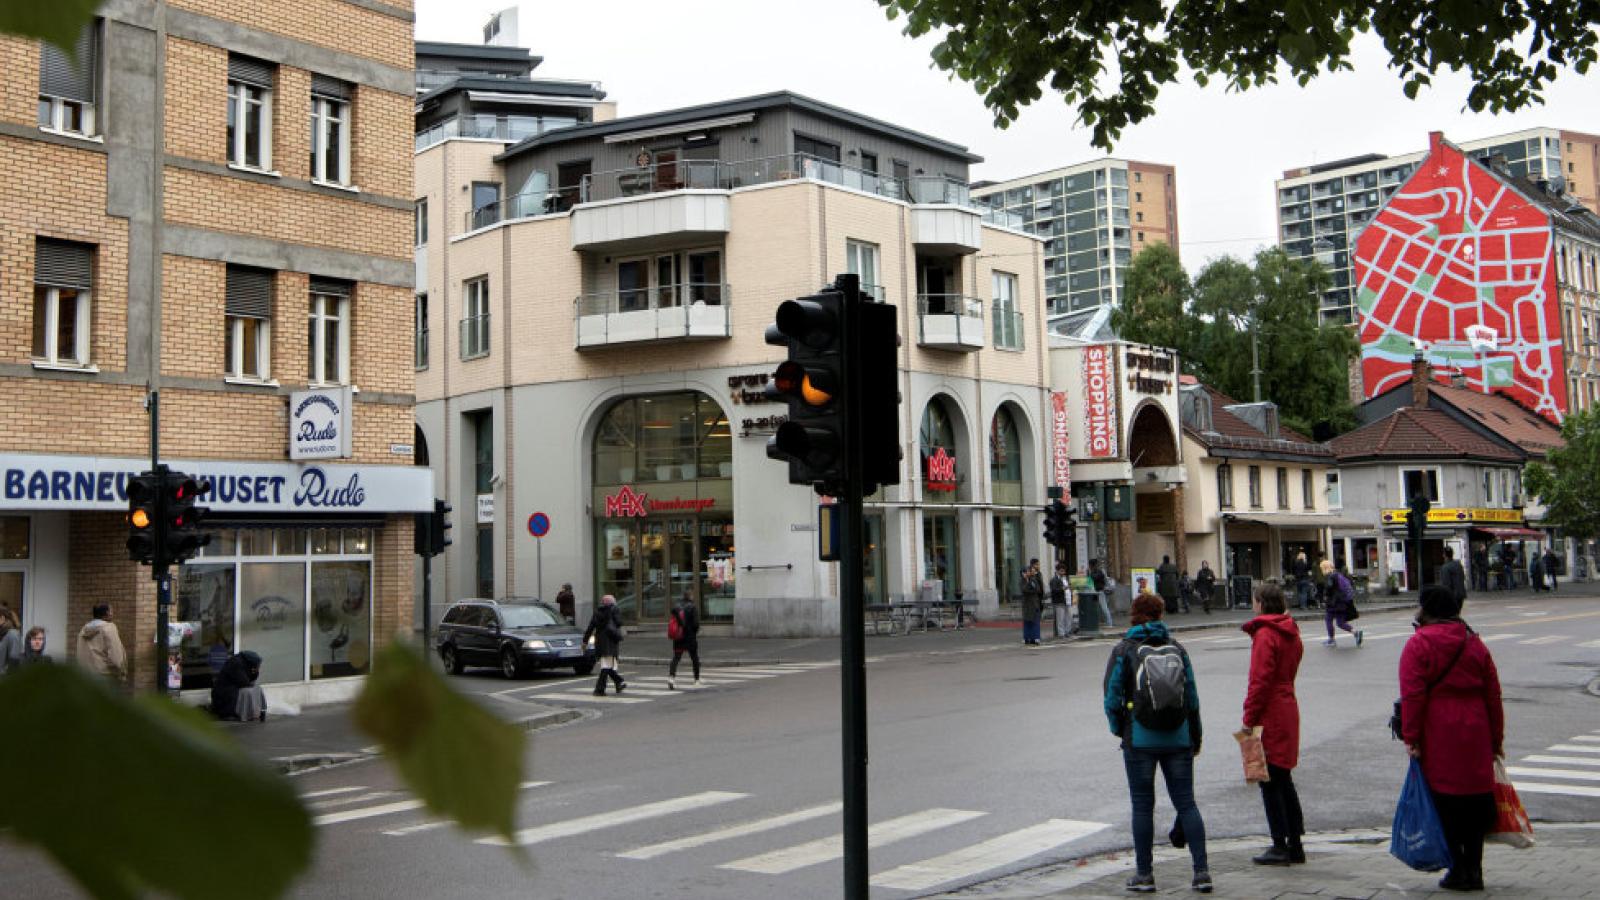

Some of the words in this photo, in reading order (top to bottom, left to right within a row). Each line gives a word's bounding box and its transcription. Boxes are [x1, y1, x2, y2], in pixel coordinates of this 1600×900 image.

[1089, 349, 1107, 450] SHOPPING
[928, 447, 956, 480] MAX
[606, 485, 647, 517] MAX
